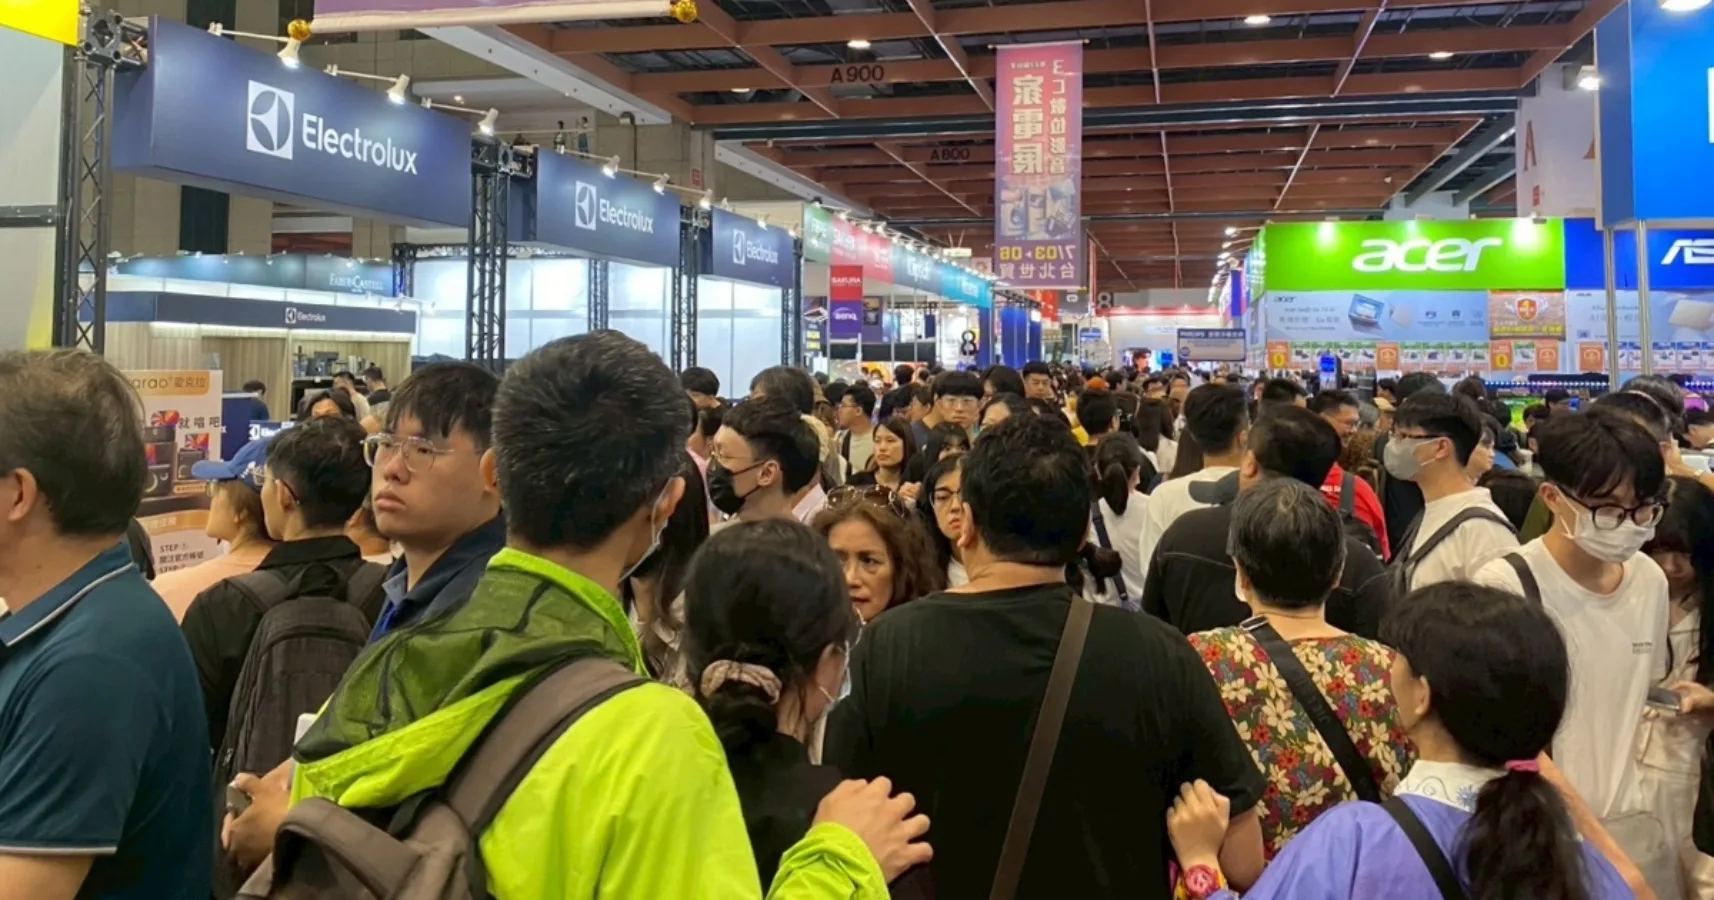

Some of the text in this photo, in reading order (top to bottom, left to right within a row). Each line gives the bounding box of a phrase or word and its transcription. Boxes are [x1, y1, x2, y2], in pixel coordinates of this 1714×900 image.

[302, 113, 418, 175] Electrolux
[600, 198, 654, 234] Electrolux
[746, 242, 779, 265] Electrolux
[1352, 237, 1503, 273] acer
[296, 311, 327, 323] Electrolux
